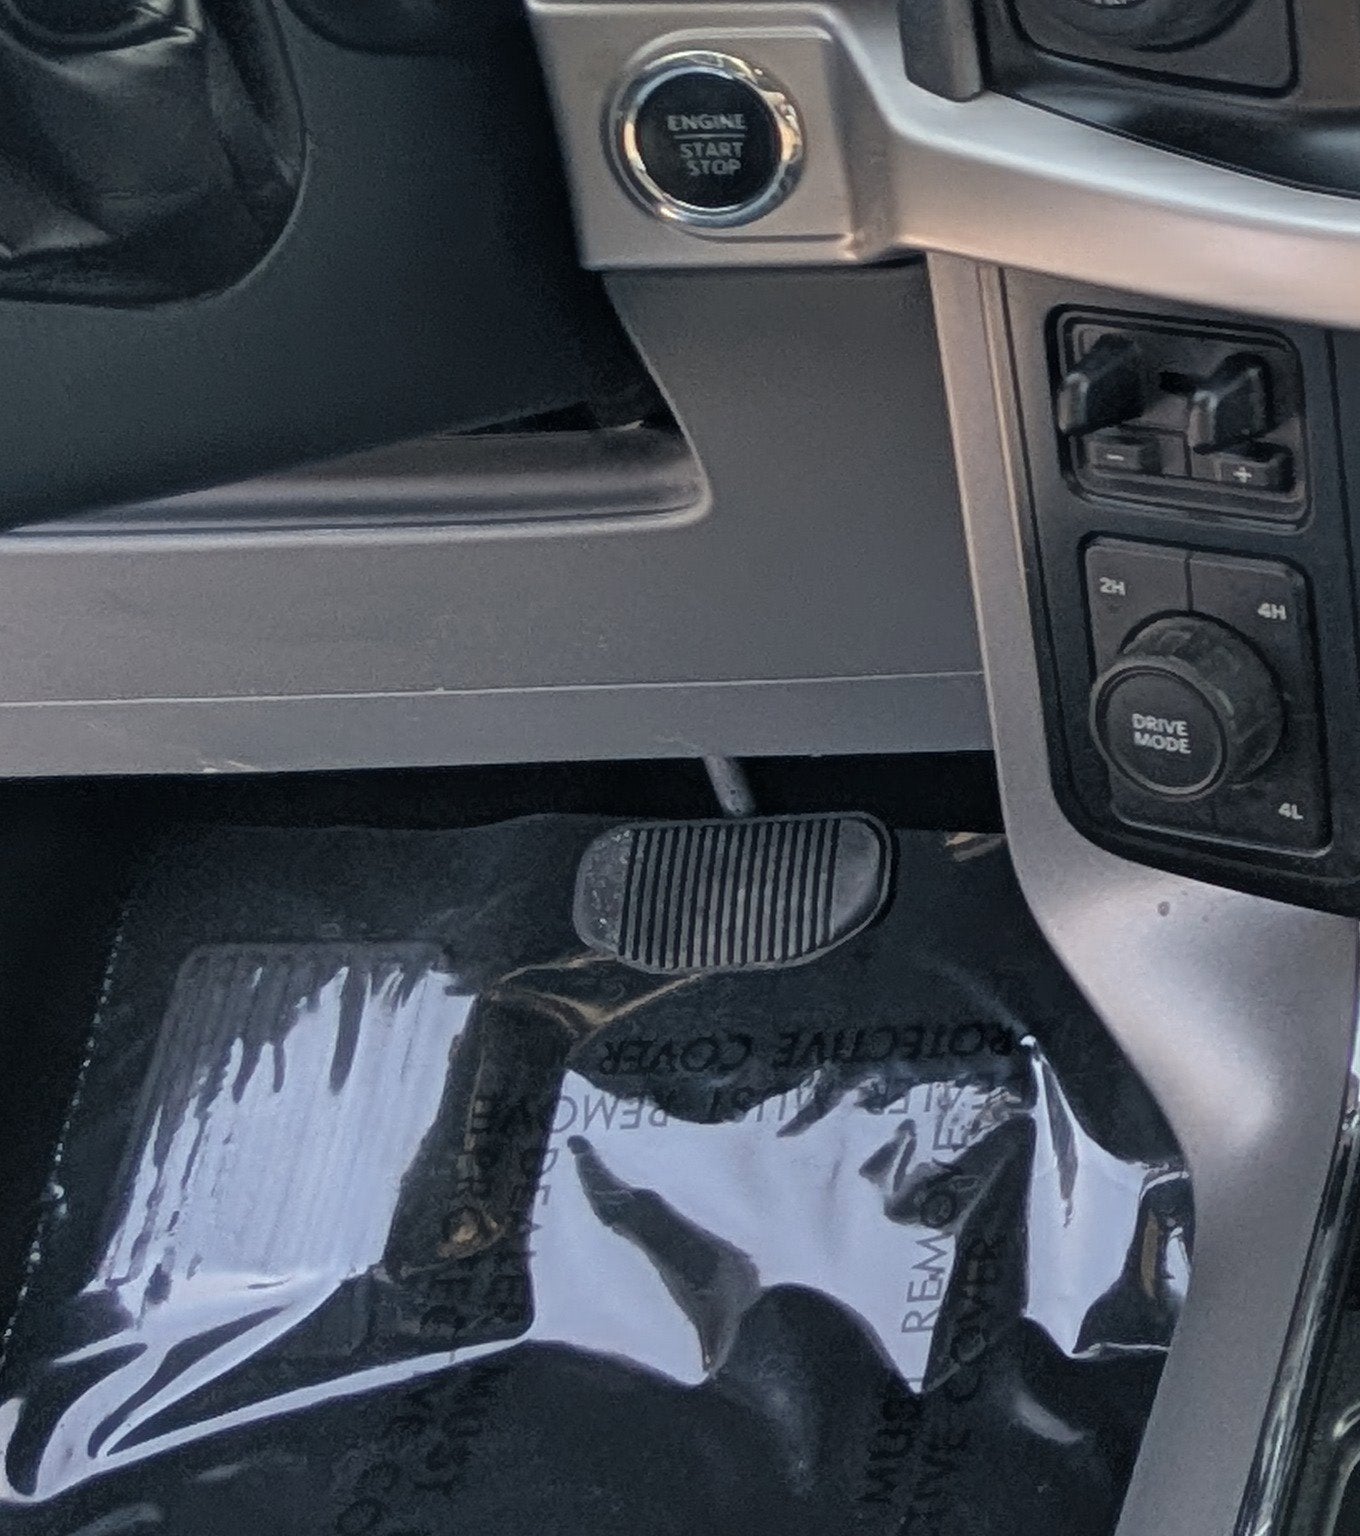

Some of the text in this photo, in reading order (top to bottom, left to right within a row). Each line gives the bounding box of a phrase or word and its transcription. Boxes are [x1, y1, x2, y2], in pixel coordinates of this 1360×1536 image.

[666, 114, 747, 131] ENGINE
[680, 141, 743, 159] START
[687, 159, 742, 176] STOP
[1099, 576, 1126, 596] 2H
[1257, 601, 1287, 620] 4H
[1131, 712, 1188, 737] DRIVE
[1133, 731, 1192, 755] MODE
[1278, 802, 1304, 821] 4L
